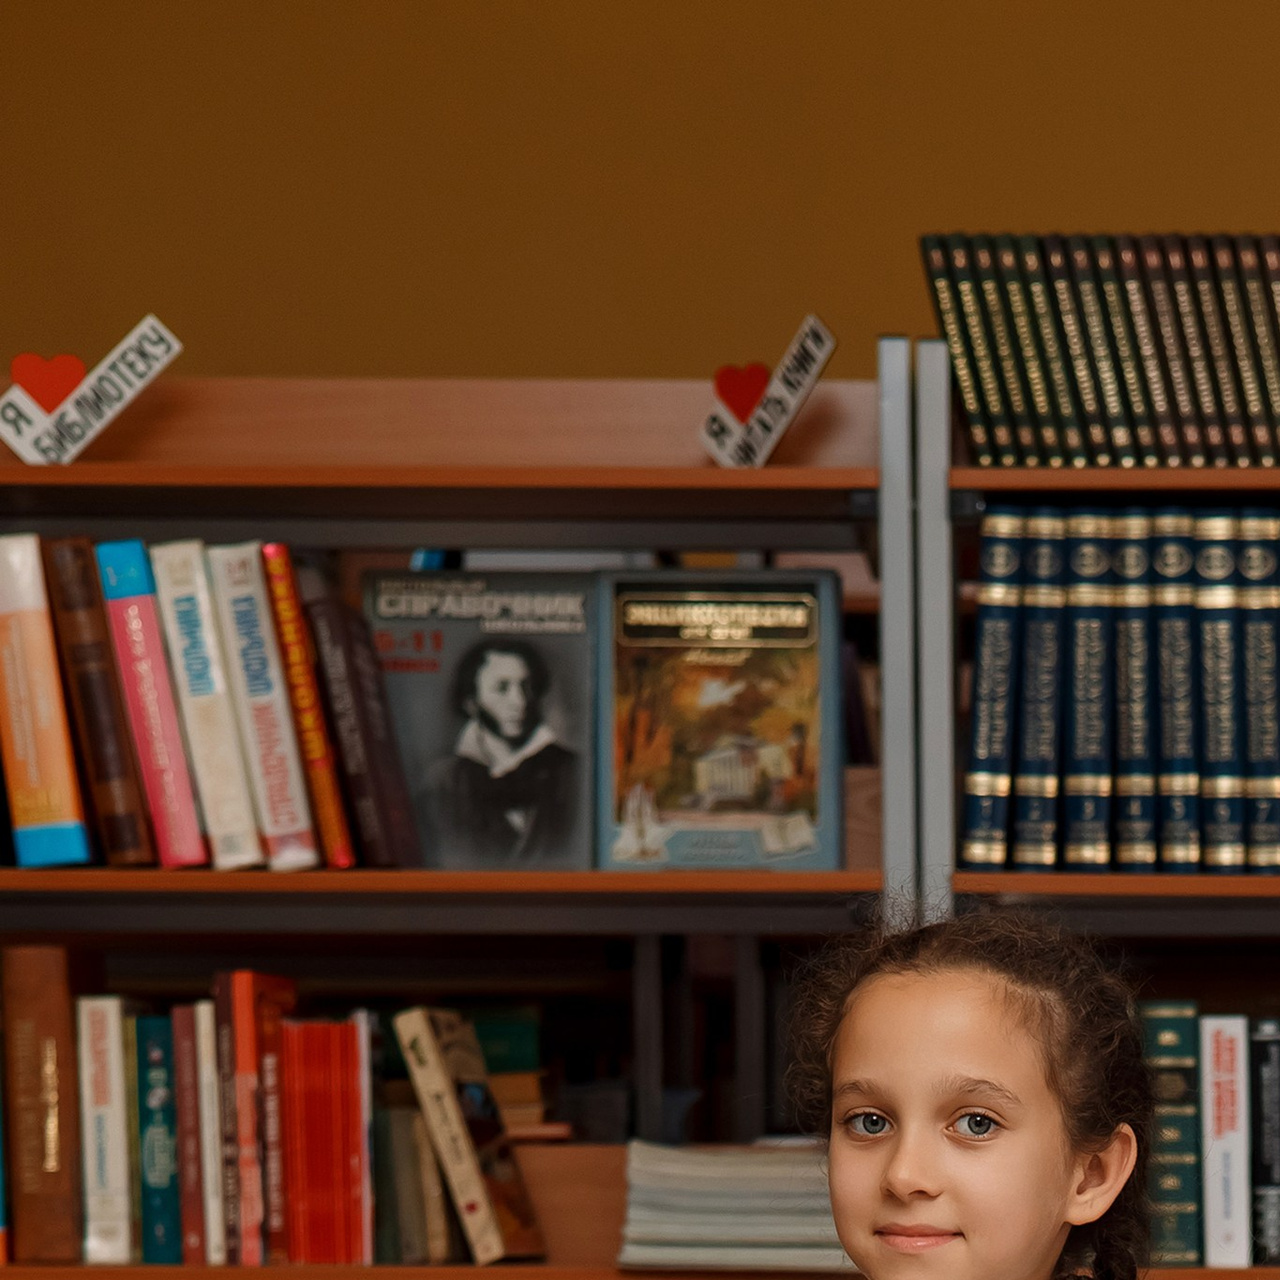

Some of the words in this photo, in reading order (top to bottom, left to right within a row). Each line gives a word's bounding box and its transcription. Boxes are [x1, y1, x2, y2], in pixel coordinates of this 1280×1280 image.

[1, 401, 33, 436] Я
[33, 324, 173, 464] БИБЛИОТЕКУ
[706, 413, 734, 450] Я
[174, 595, 216, 697] ШКОЛЬНИКА
[229, 595, 274, 698] ШКОЛЬНИКА
[377, 592, 585, 619] СПРАВОЧНИК
